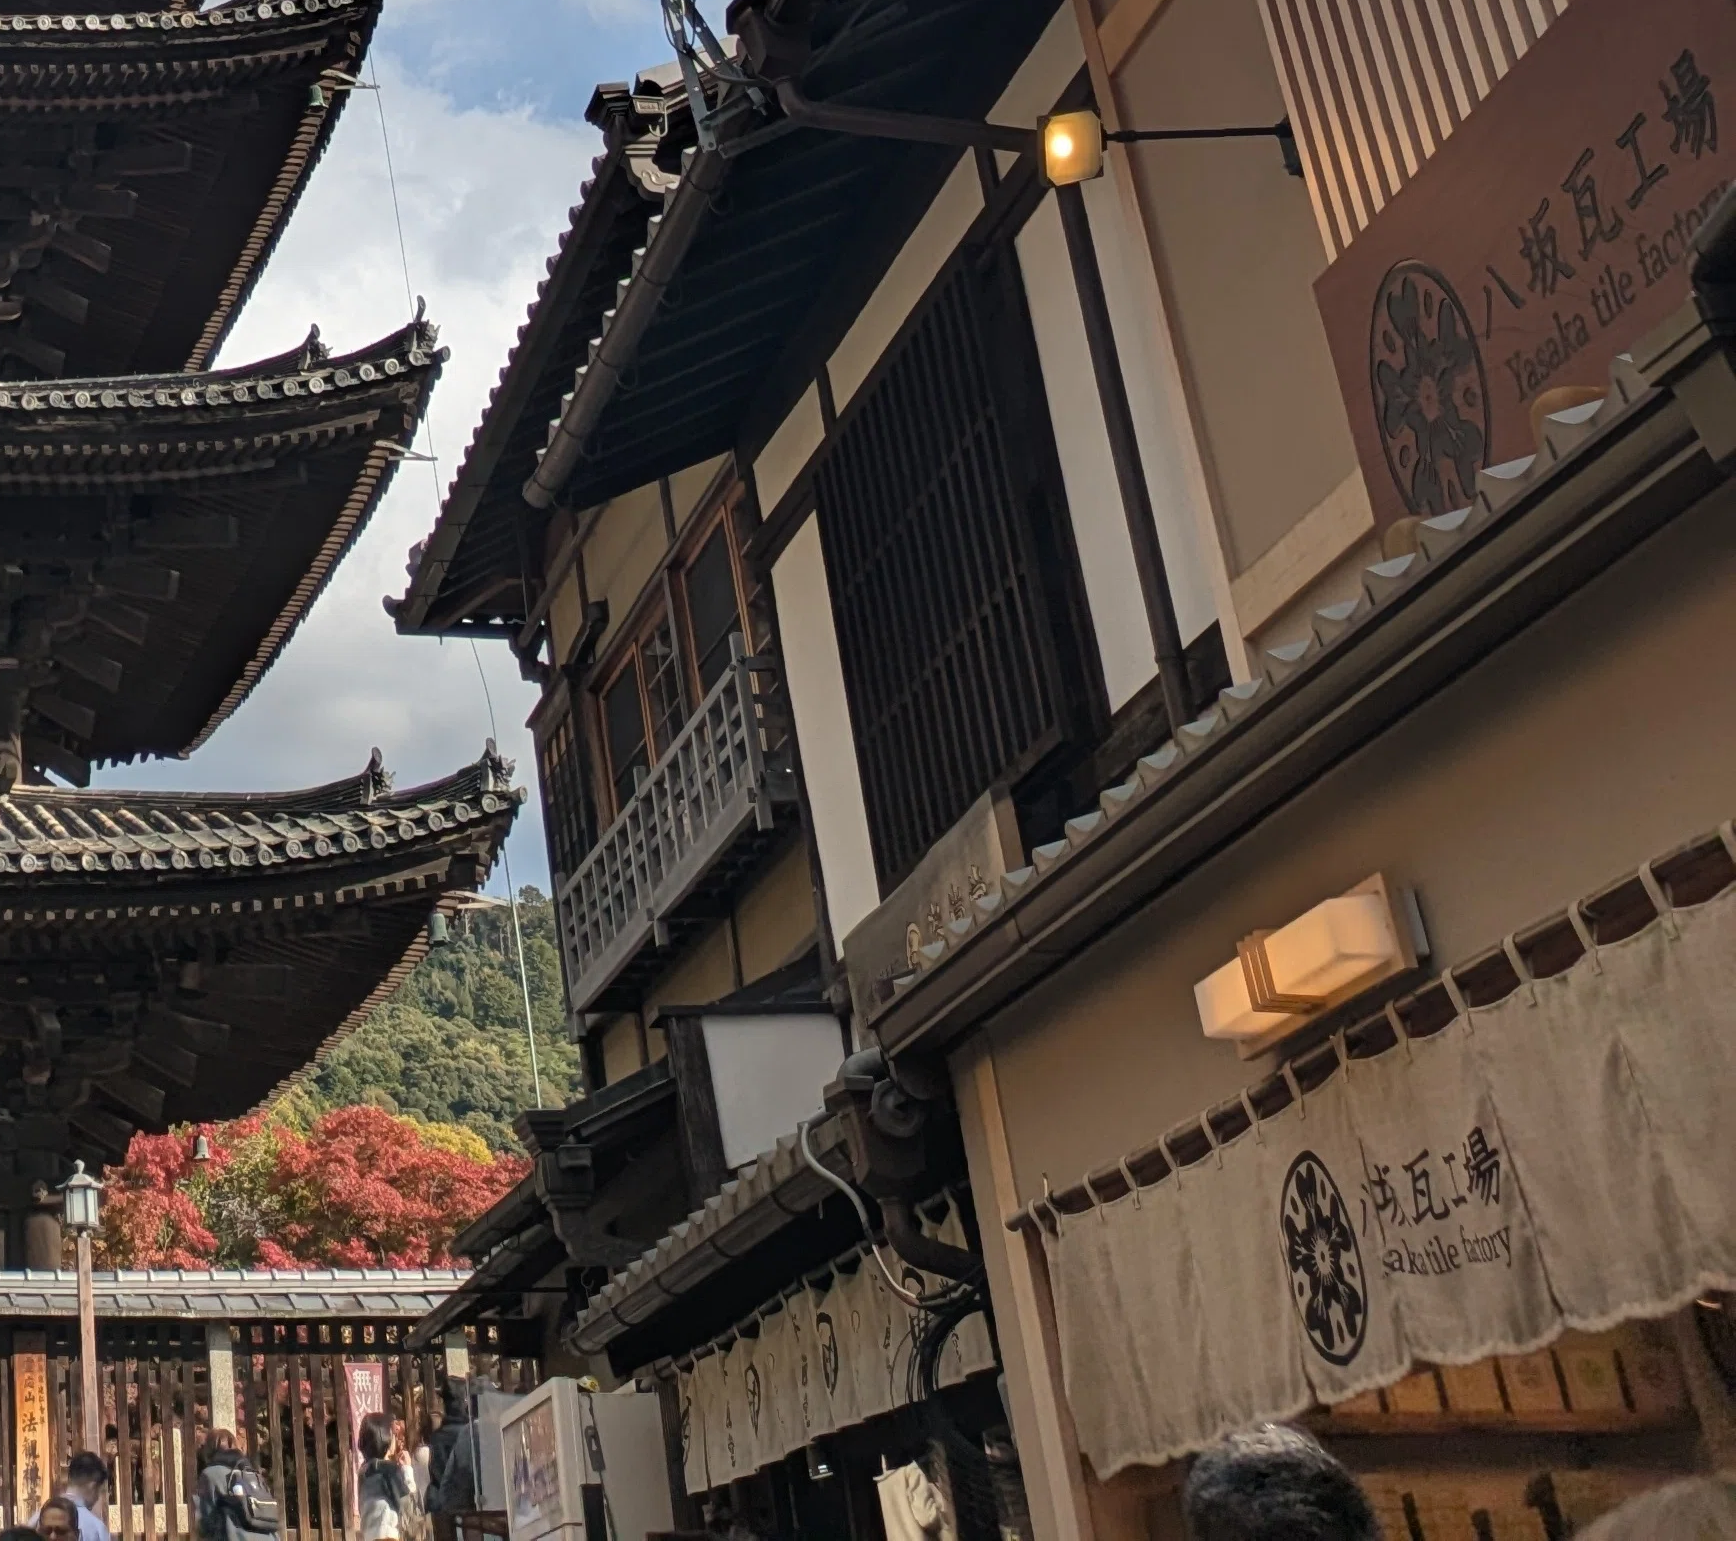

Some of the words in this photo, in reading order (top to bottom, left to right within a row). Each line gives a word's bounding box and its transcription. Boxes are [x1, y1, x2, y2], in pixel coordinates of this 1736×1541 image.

[1483, 48, 1718, 342] 八坂瓦工場
[1504, 311, 1590, 404] Yasaka
[1590, 264, 1638, 328] tile
